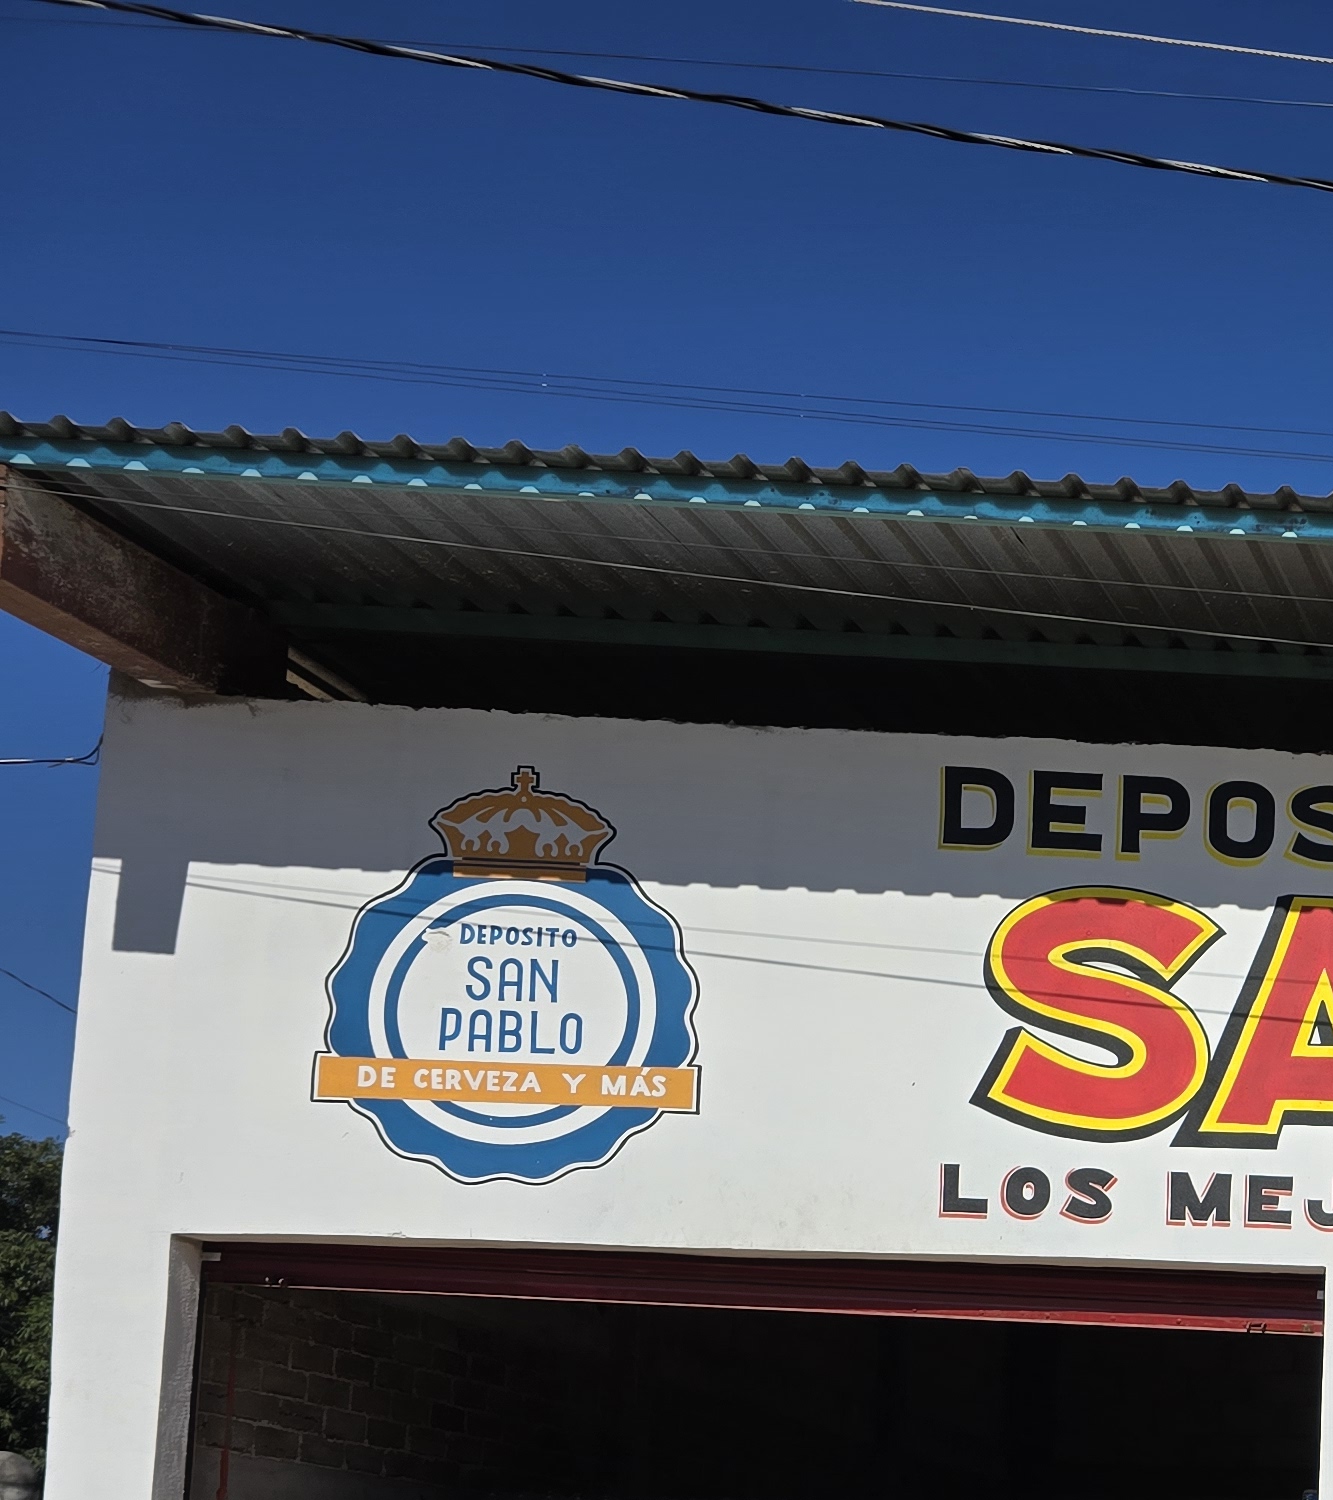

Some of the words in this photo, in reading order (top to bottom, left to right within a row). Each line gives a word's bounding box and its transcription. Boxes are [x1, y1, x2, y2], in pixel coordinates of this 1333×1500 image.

[460, 924, 577, 947] DEPOSITO
[466, 956, 559, 1002] SAN
[439, 1008, 583, 1054] PABLO
[357, 1066, 396, 1088] DE
[414, 1068, 541, 1093] CERVEZA
[562, 1073, 586, 1093] Y
[602, 1068, 666, 1097] MÁS
[939, 1163, 1118, 1224] LOS
